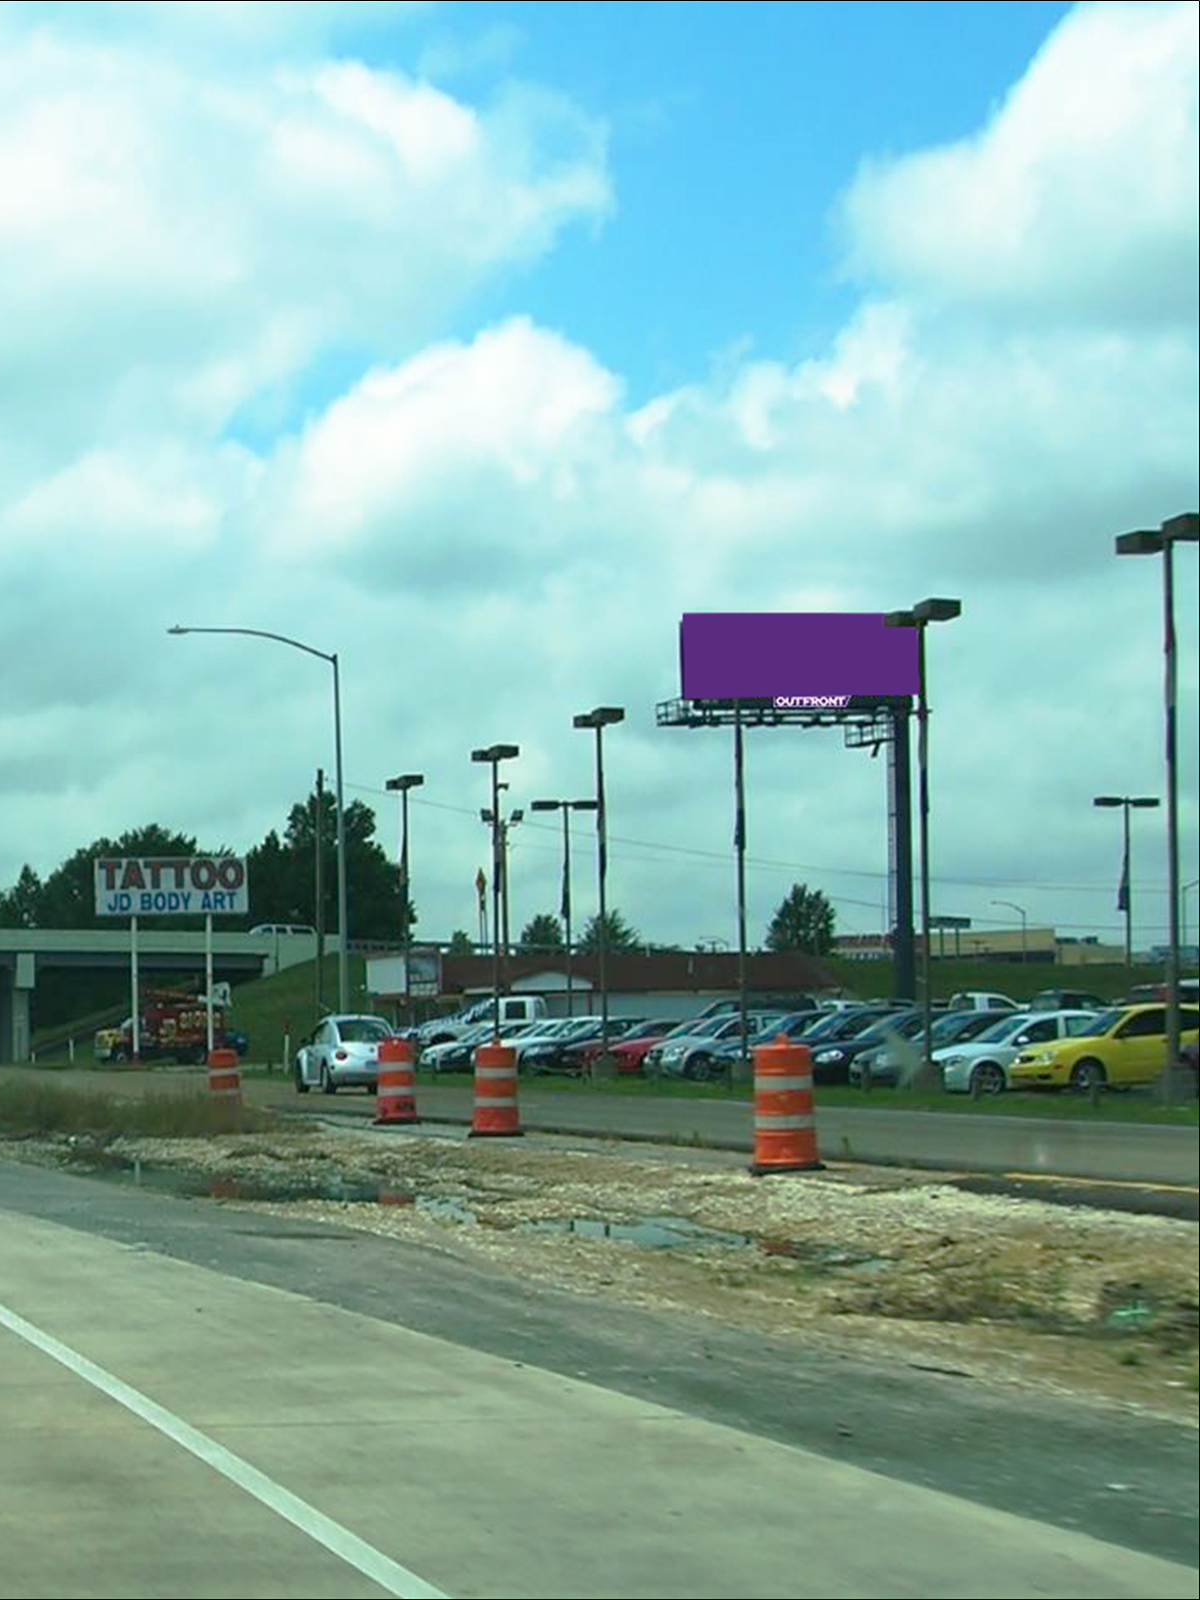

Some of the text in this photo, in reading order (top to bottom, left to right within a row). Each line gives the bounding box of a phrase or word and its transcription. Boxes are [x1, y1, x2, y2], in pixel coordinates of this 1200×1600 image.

[776, 696, 846, 707] OUTFRONT
[99, 860, 244, 890] TATTOO
[107, 891, 237, 912] JD BODY ART
